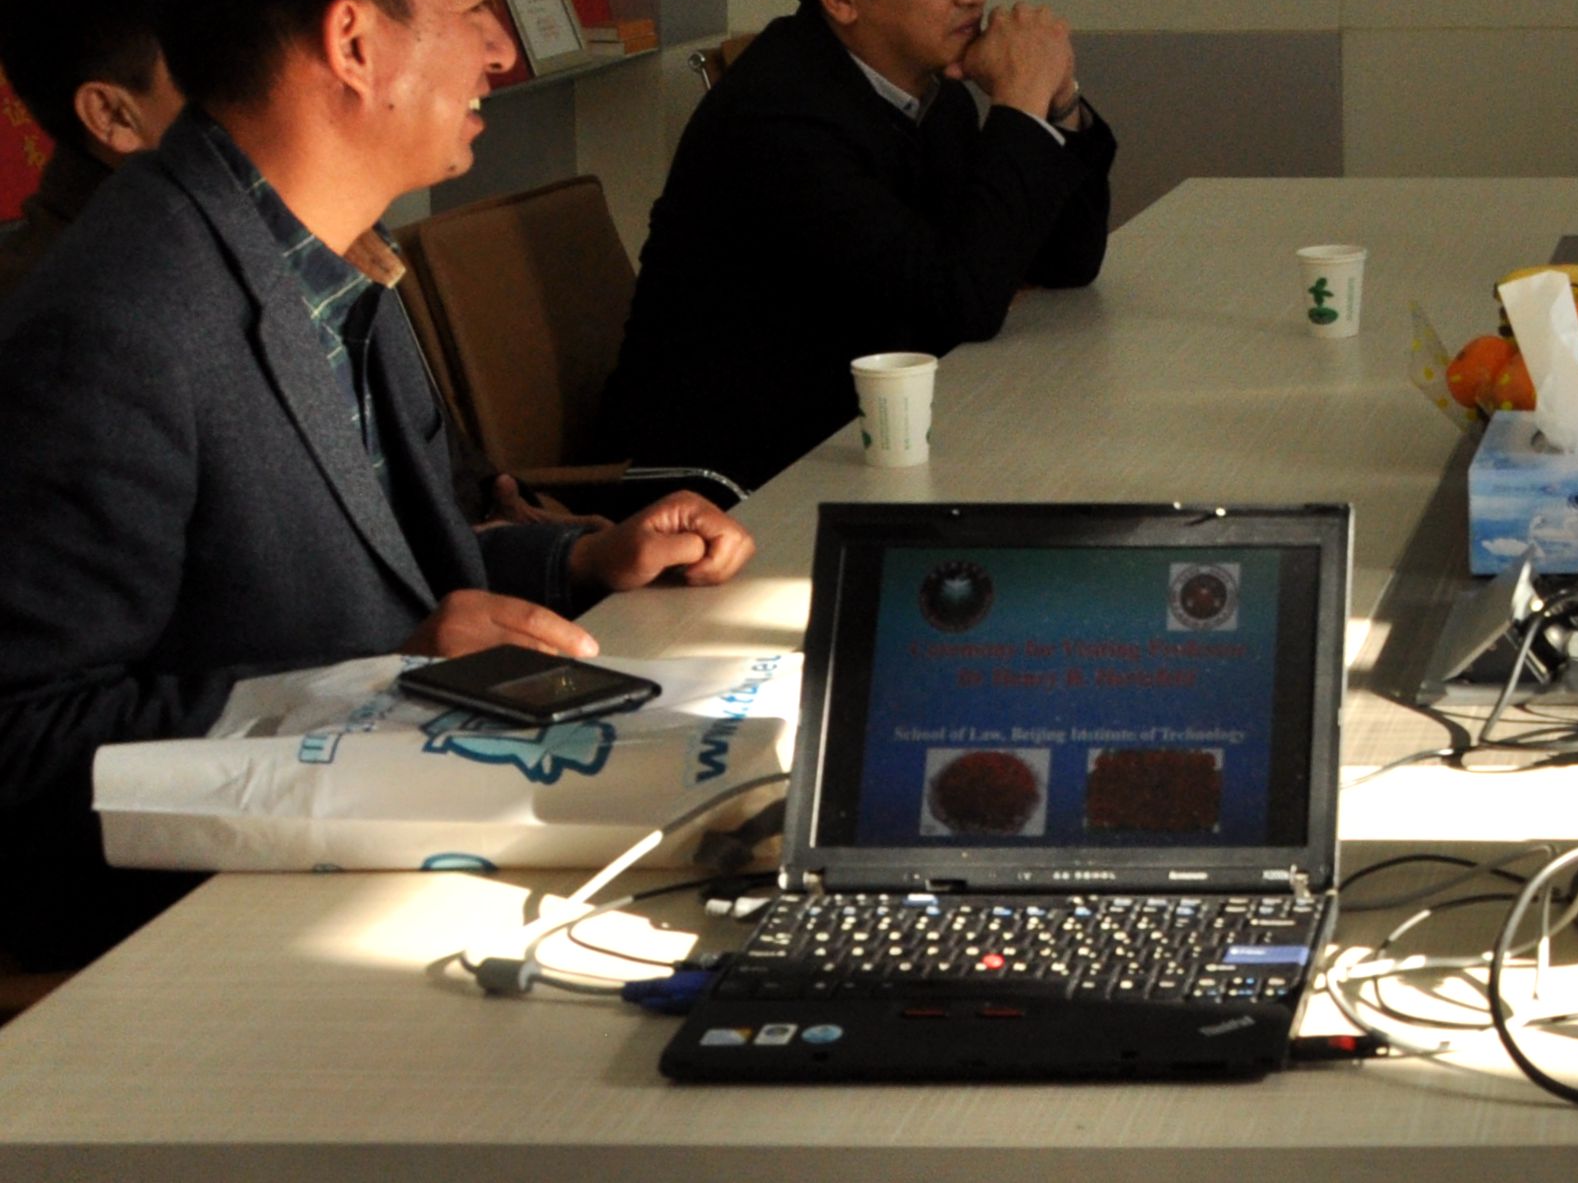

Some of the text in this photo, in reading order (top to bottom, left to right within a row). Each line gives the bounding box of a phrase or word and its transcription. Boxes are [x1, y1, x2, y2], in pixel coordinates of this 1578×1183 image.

[894, 726, 945, 741] School
[948, 726, 966, 740] of
[1011, 726, 1068, 743] Beijing
[1139, 726, 1158, 741] of
[1160, 726, 1247, 744] Technology
